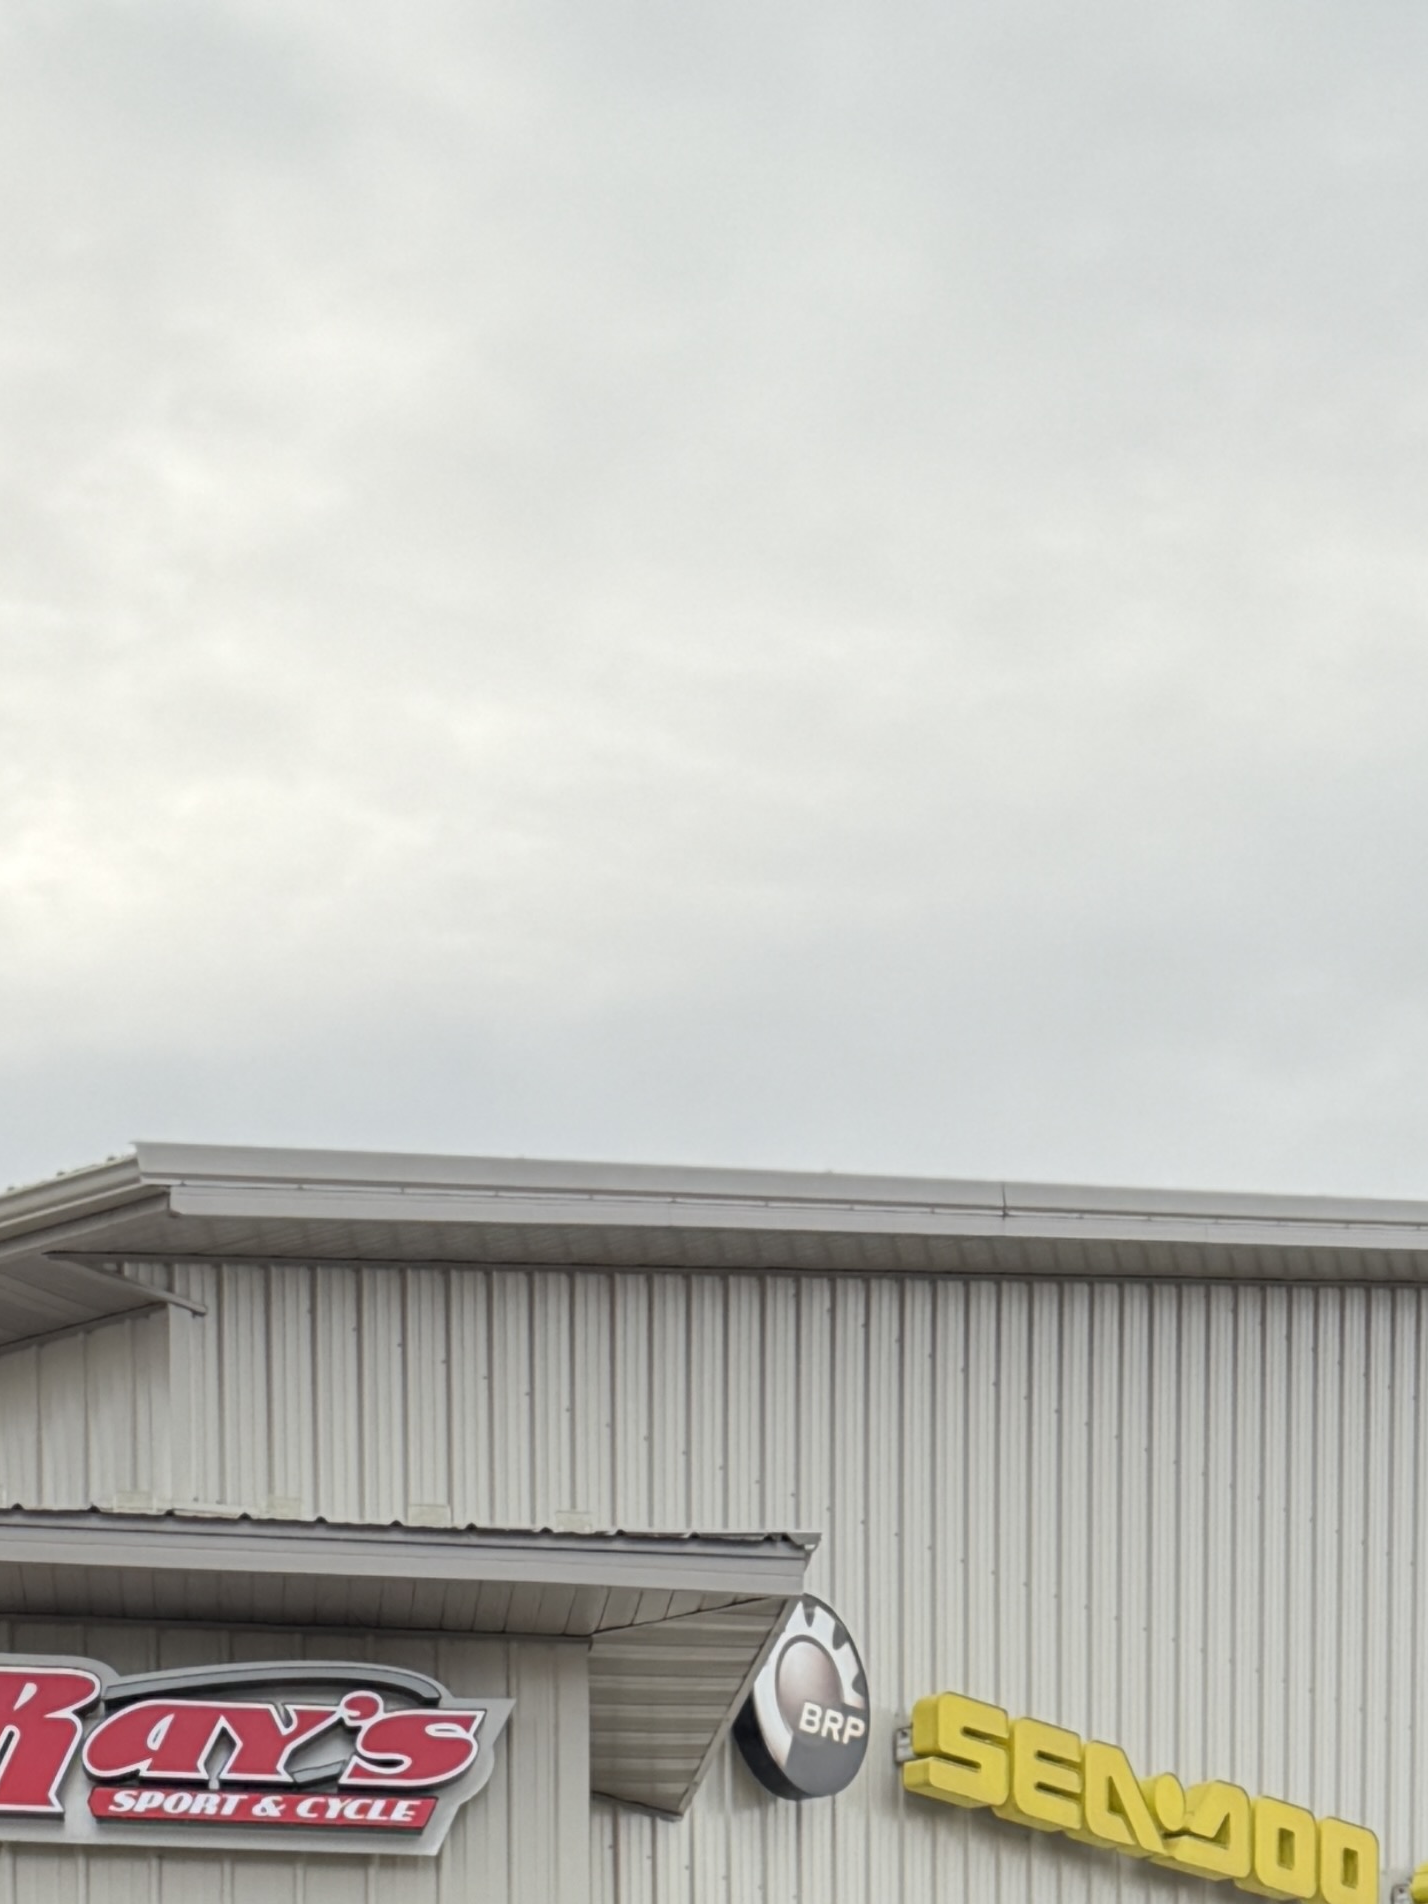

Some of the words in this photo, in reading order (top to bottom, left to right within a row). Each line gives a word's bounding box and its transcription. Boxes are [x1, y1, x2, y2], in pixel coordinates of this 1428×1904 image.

[798, 1702, 865, 1746] BRP
[109, 1788, 239, 1816] SPORT
[252, 1795, 284, 1819] &
[297, 1797, 420, 1824] CYCLE
